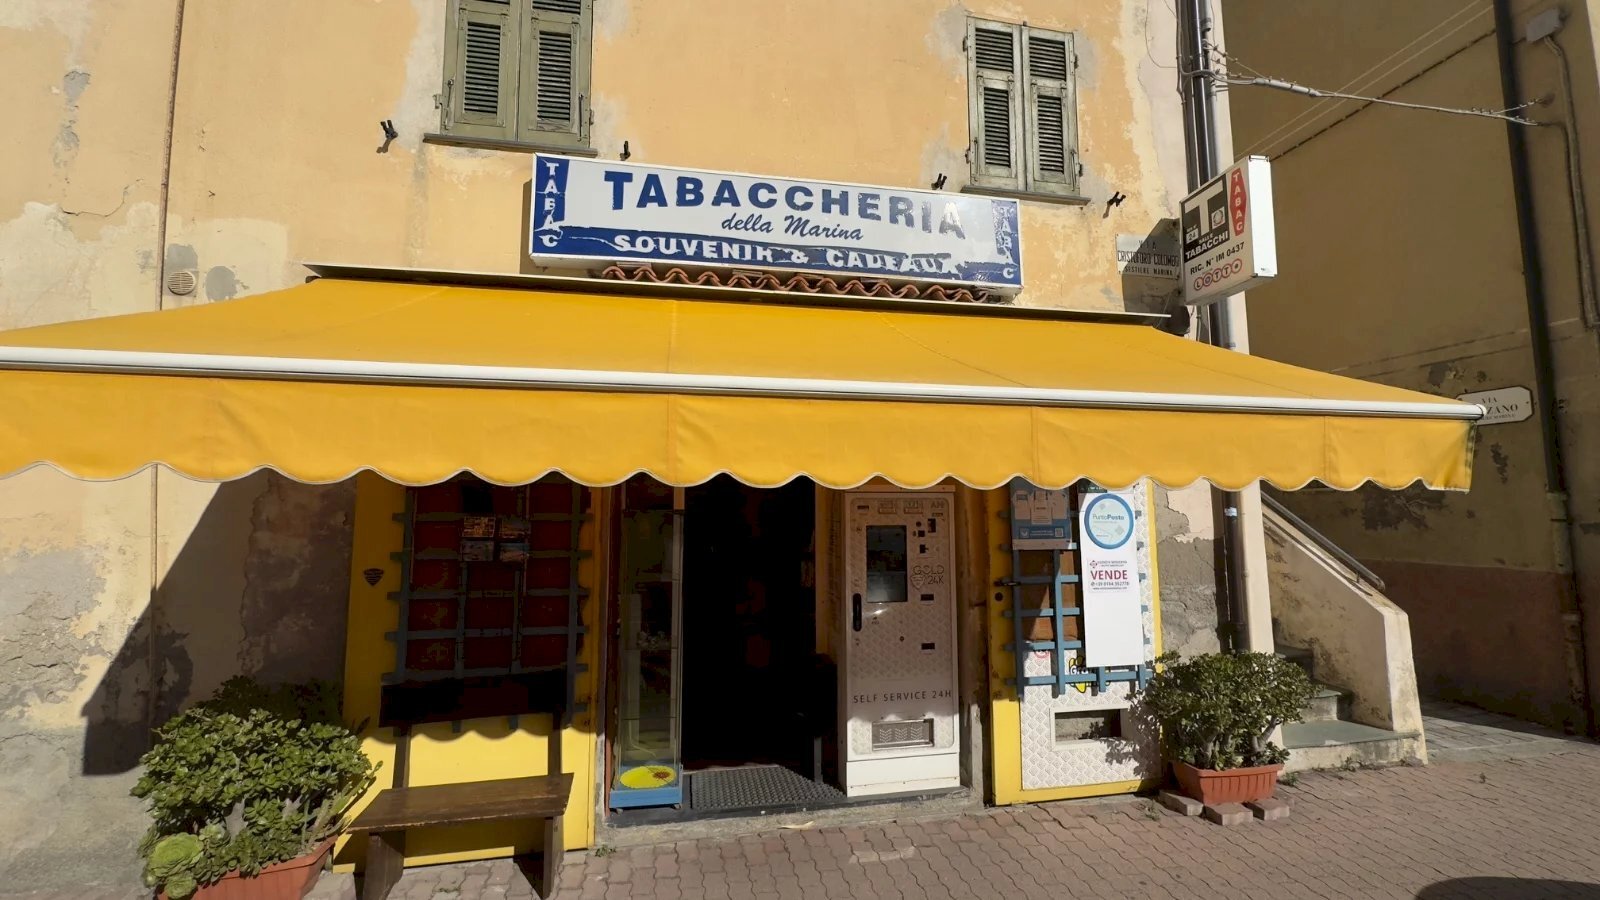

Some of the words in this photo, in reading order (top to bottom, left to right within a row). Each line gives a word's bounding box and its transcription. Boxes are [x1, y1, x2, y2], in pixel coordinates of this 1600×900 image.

[543, 162, 560, 247] TABAC
[604, 170, 966, 240] TABACCHERIA
[1232, 171, 1243, 232] TABAC
[721, 212, 773, 233] della
[783, 214, 864, 240] Marina
[613, 235, 773, 262] SOUVENIR
[1185, 230, 1228, 259] TABACCHI
[1216, 252, 1225, 262] IM
[1226, 241, 1245, 257] 0437
[1193, 258, 1243, 291] LOTTO
[1481, 396, 1498, 404] VIA
[1486, 404, 1518, 415] ZANO
[913, 564, 944, 575] GOLD
[1090, 569, 1128, 580] VENDE
[853, 694, 878, 704] SELF
[883, 690, 927, 702] SERVICE
[932, 689, 952, 699] 24H
